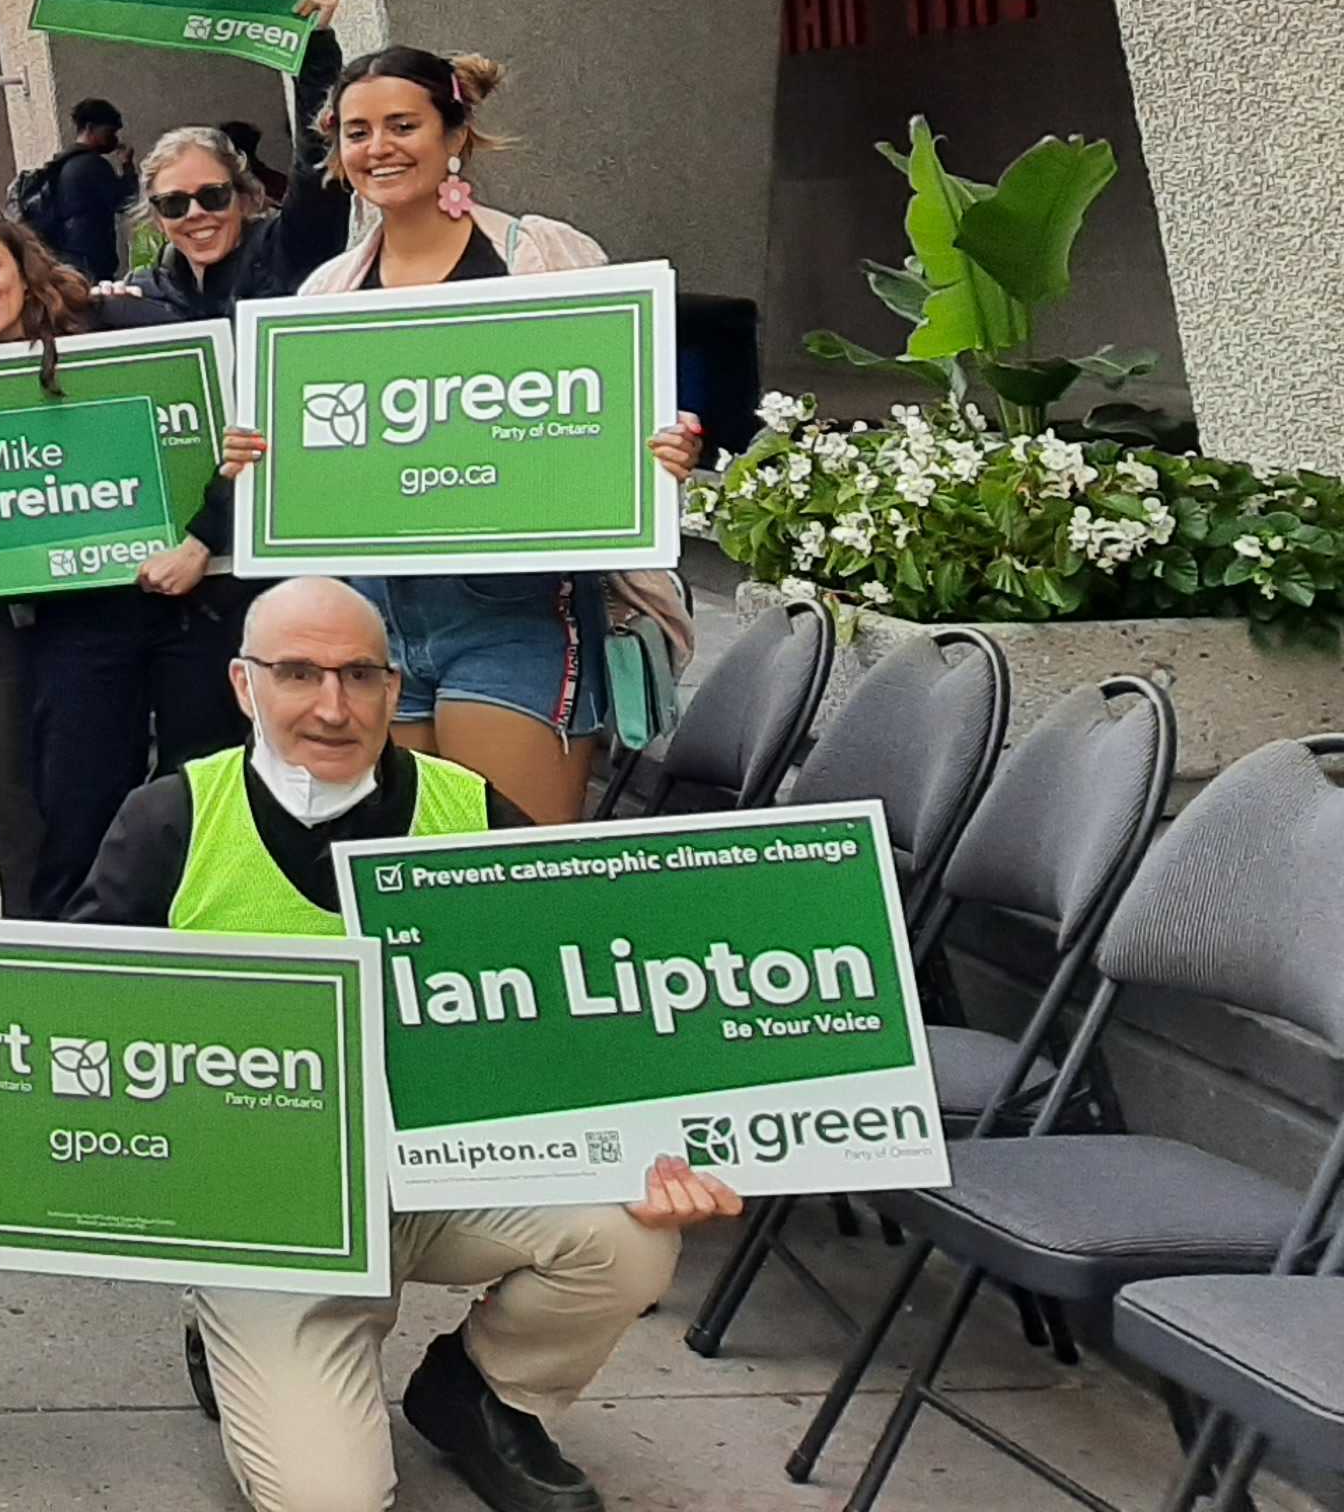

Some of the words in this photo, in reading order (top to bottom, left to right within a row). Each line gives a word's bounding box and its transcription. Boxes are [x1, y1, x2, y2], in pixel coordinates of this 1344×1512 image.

[213, 17, 300, 52] green
[380, 366, 602, 444] green
[491, 425, 525, 442] Party
[529, 424, 544, 438] of
[547, 422, 601, 437] Ontario
[400, 463, 497, 496] gpo.ca
[79, 536, 165, 574] green
[412, 862, 506, 888] Prevent
[510, 849, 661, 880] catastrophic
[666, 841, 758, 870] climate
[762, 835, 858, 864] change
[387, 926, 421, 944] Let
[390, 955, 538, 1027] Ian
[559, 938, 875, 1035] Lipton
[722, 1019, 752, 1039] Be
[756, 1015, 812, 1037] Your
[814, 1010, 882, 1033] Voice
[122, 1039, 323, 1098] green
[225, 1092, 256, 1109] Party
[259, 1093, 272, 1107] of
[275, 1094, 323, 1110] Ontario
[49, 1128, 170, 1162] gpo.ca
[747, 1103, 929, 1163] green
[396, 1137, 579, 1168] IanLipton.ca
